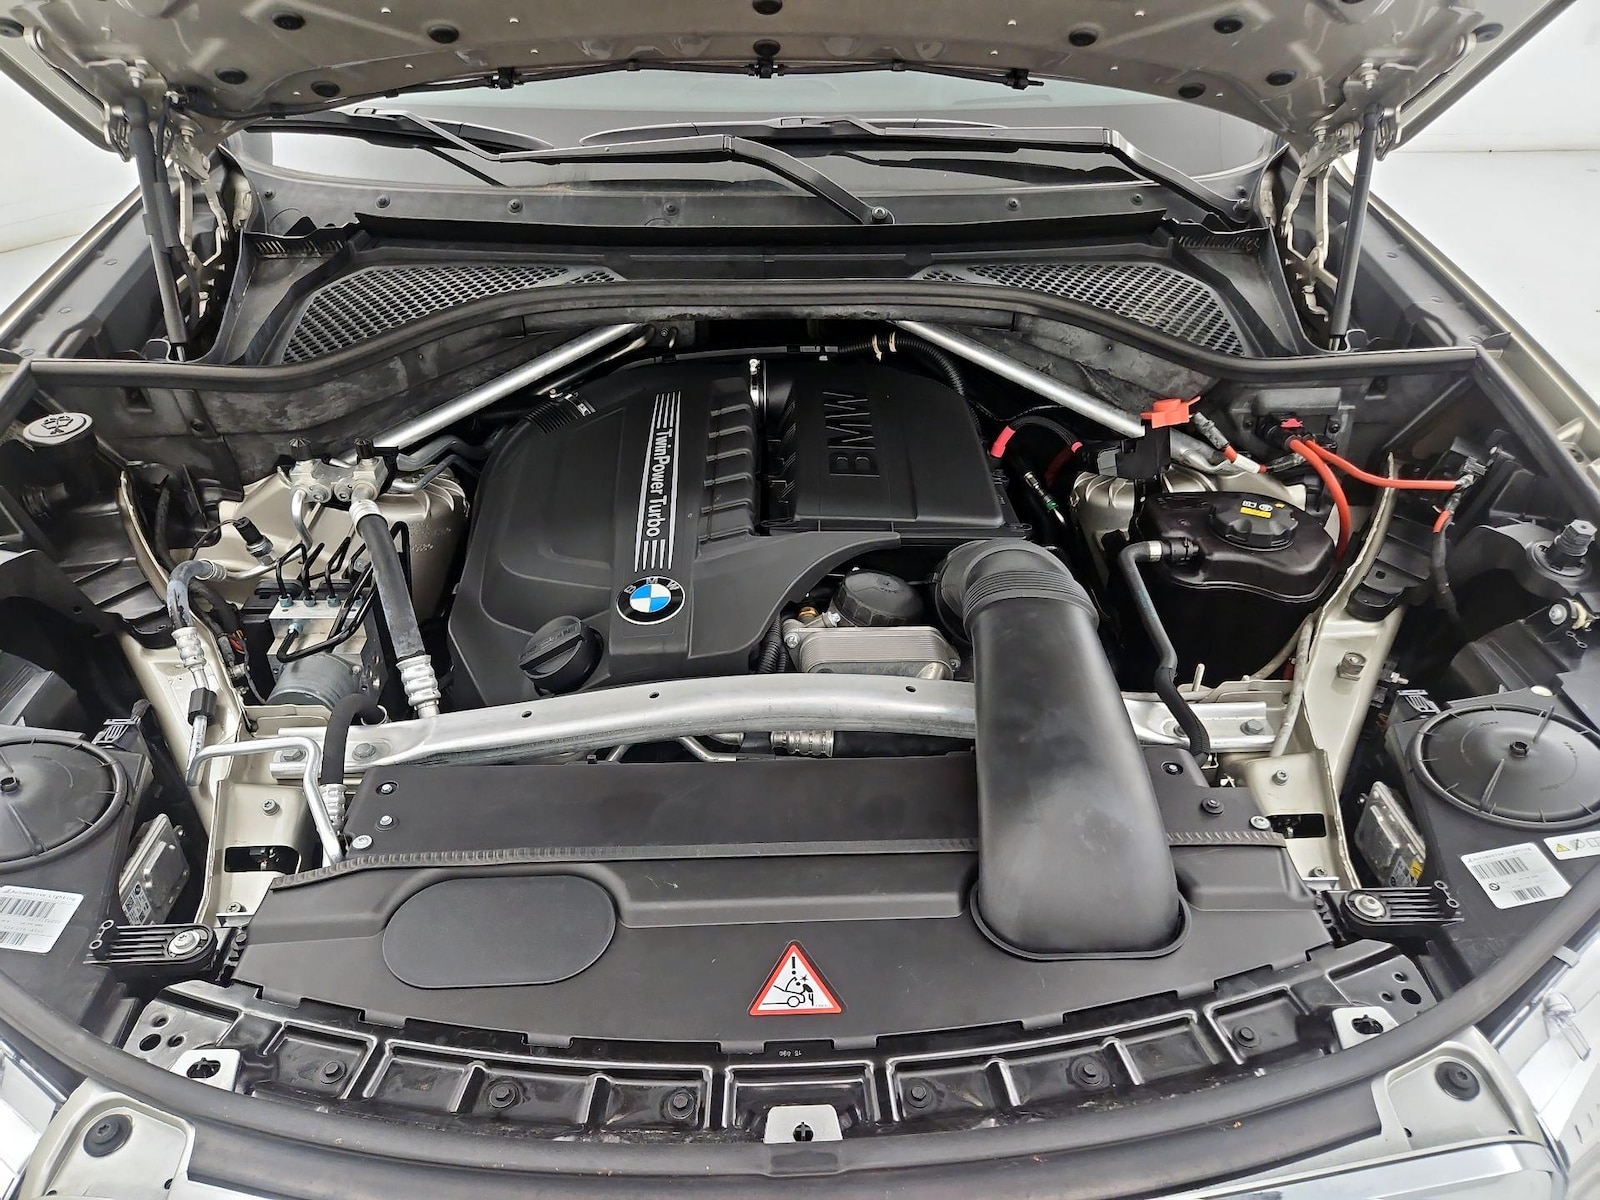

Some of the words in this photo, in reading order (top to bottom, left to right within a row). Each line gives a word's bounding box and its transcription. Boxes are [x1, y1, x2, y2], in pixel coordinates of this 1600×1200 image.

[650, 428, 673, 494] TwinPower
[822, 390, 880, 478] BMW
[645, 495, 668, 537] Turbo
[624, 577, 681, 594] BMW
